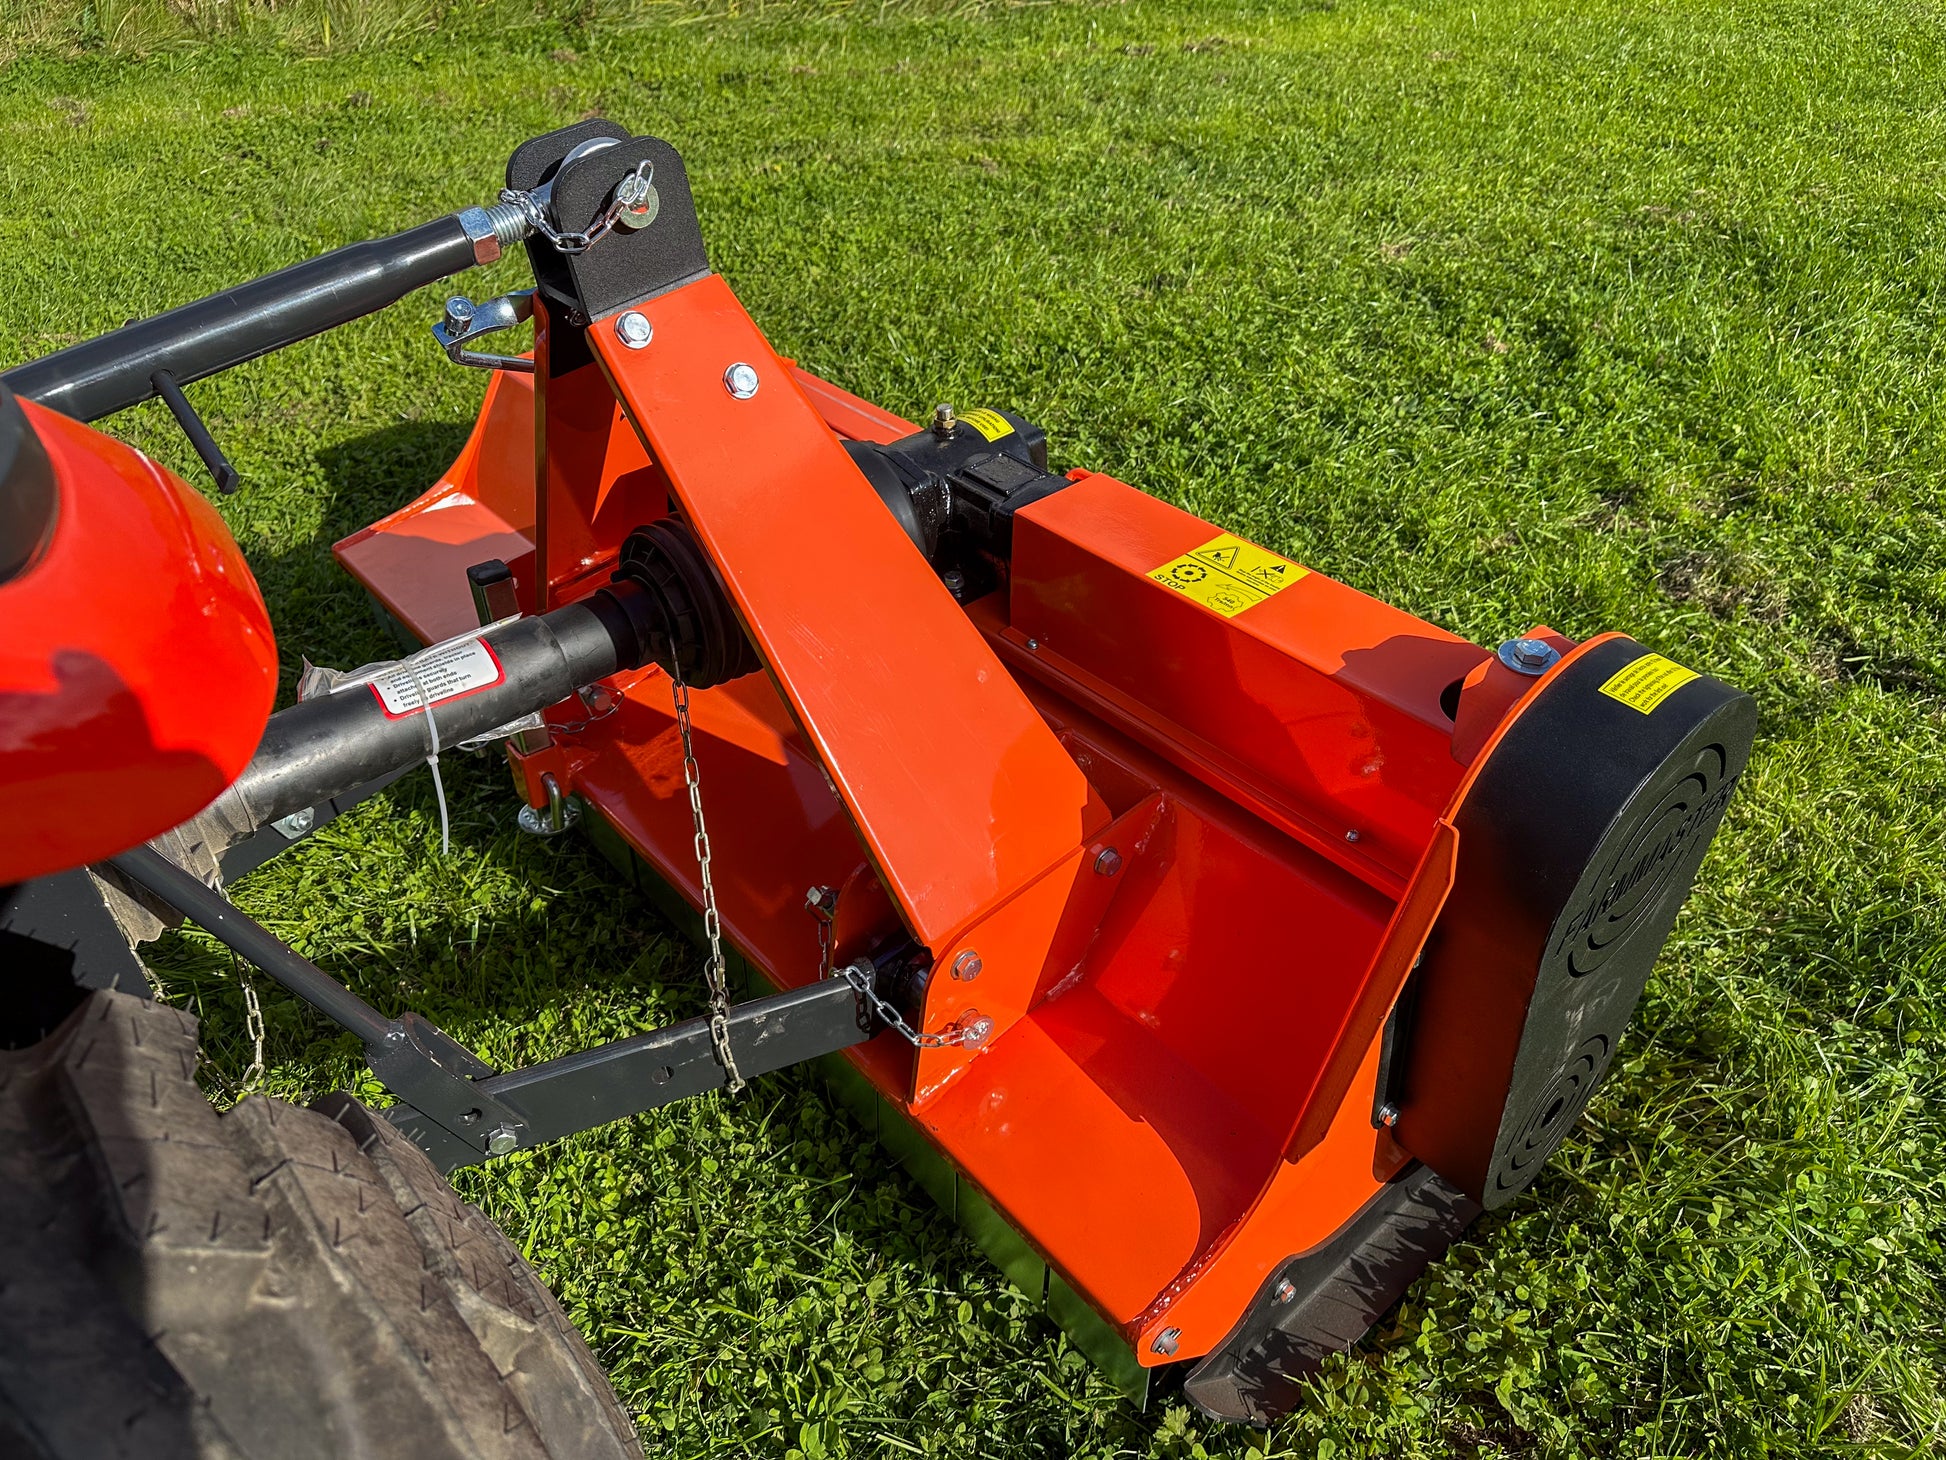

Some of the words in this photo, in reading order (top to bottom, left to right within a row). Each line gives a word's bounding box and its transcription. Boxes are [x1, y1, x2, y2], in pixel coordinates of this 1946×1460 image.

[1154, 574, 1186, 590] STOP
[433, 658, 454, 668] shields
[460, 651, 476, 660] place
[423, 668, 447, 679] securely
[429, 675, 442, 684] both
[442, 671, 457, 680] ends
[427, 682, 446, 692] guards
[447, 676, 459, 685] that
[459, 673, 472, 681] turn
[403, 699, 420, 708] freely
[429, 687, 454, 699] driveline
[1554, 774, 1738, 959] FARMMASTER
